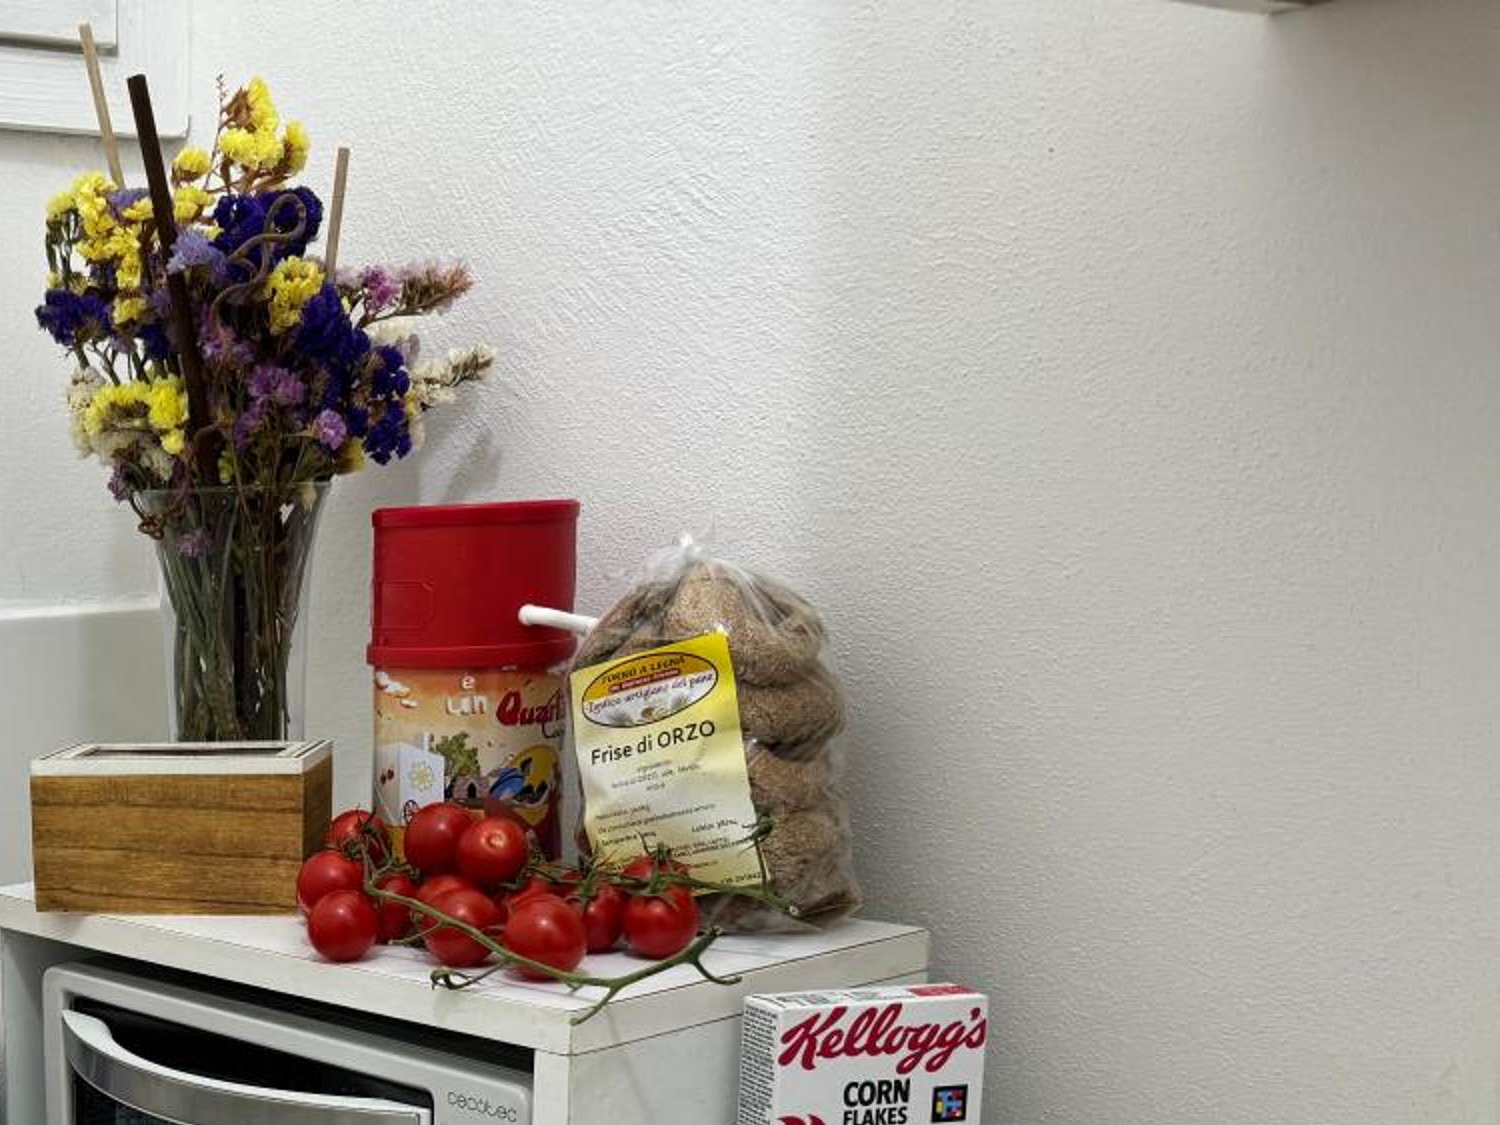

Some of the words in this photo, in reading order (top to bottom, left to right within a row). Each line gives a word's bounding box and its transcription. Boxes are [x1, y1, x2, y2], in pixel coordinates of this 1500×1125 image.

[591, 743, 633, 766] Frise
[637, 733, 653, 755] di
[657, 719, 716, 749] ORZO
[778, 1002, 987, 1075] Kellogg's
[843, 1078, 911, 1107] CORN
